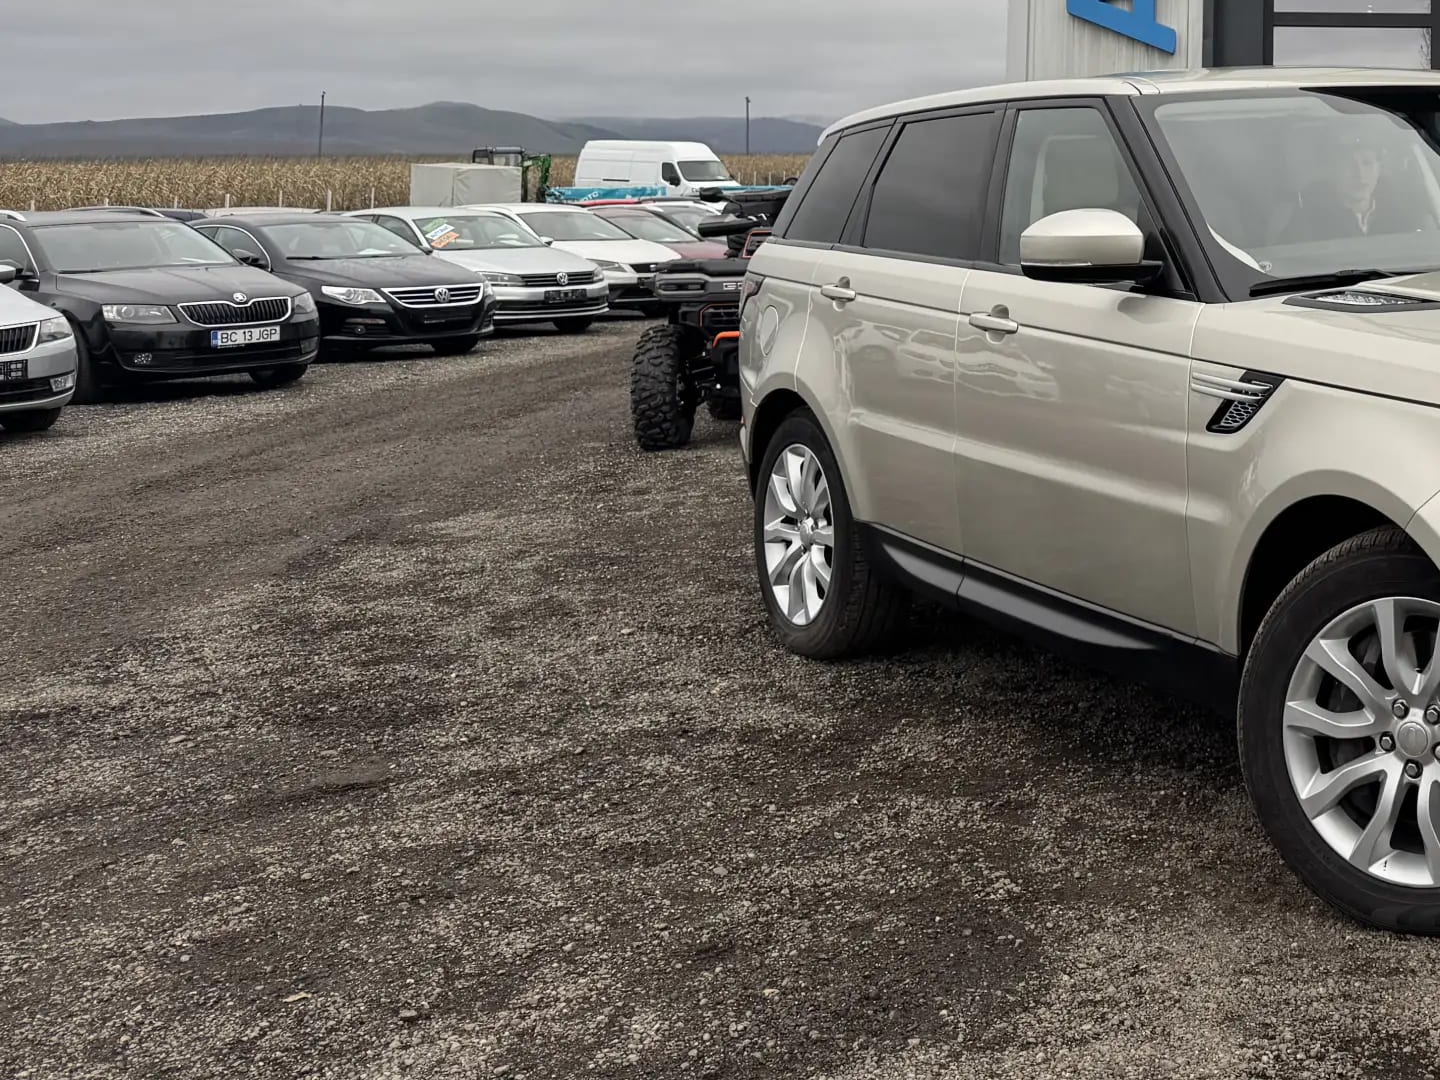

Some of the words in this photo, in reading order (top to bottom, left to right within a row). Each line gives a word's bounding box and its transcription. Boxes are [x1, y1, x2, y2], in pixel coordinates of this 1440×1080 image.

[220, 331, 238, 344] BC
[242, 330, 253, 342] 13
[255, 328, 278, 341] JGP
